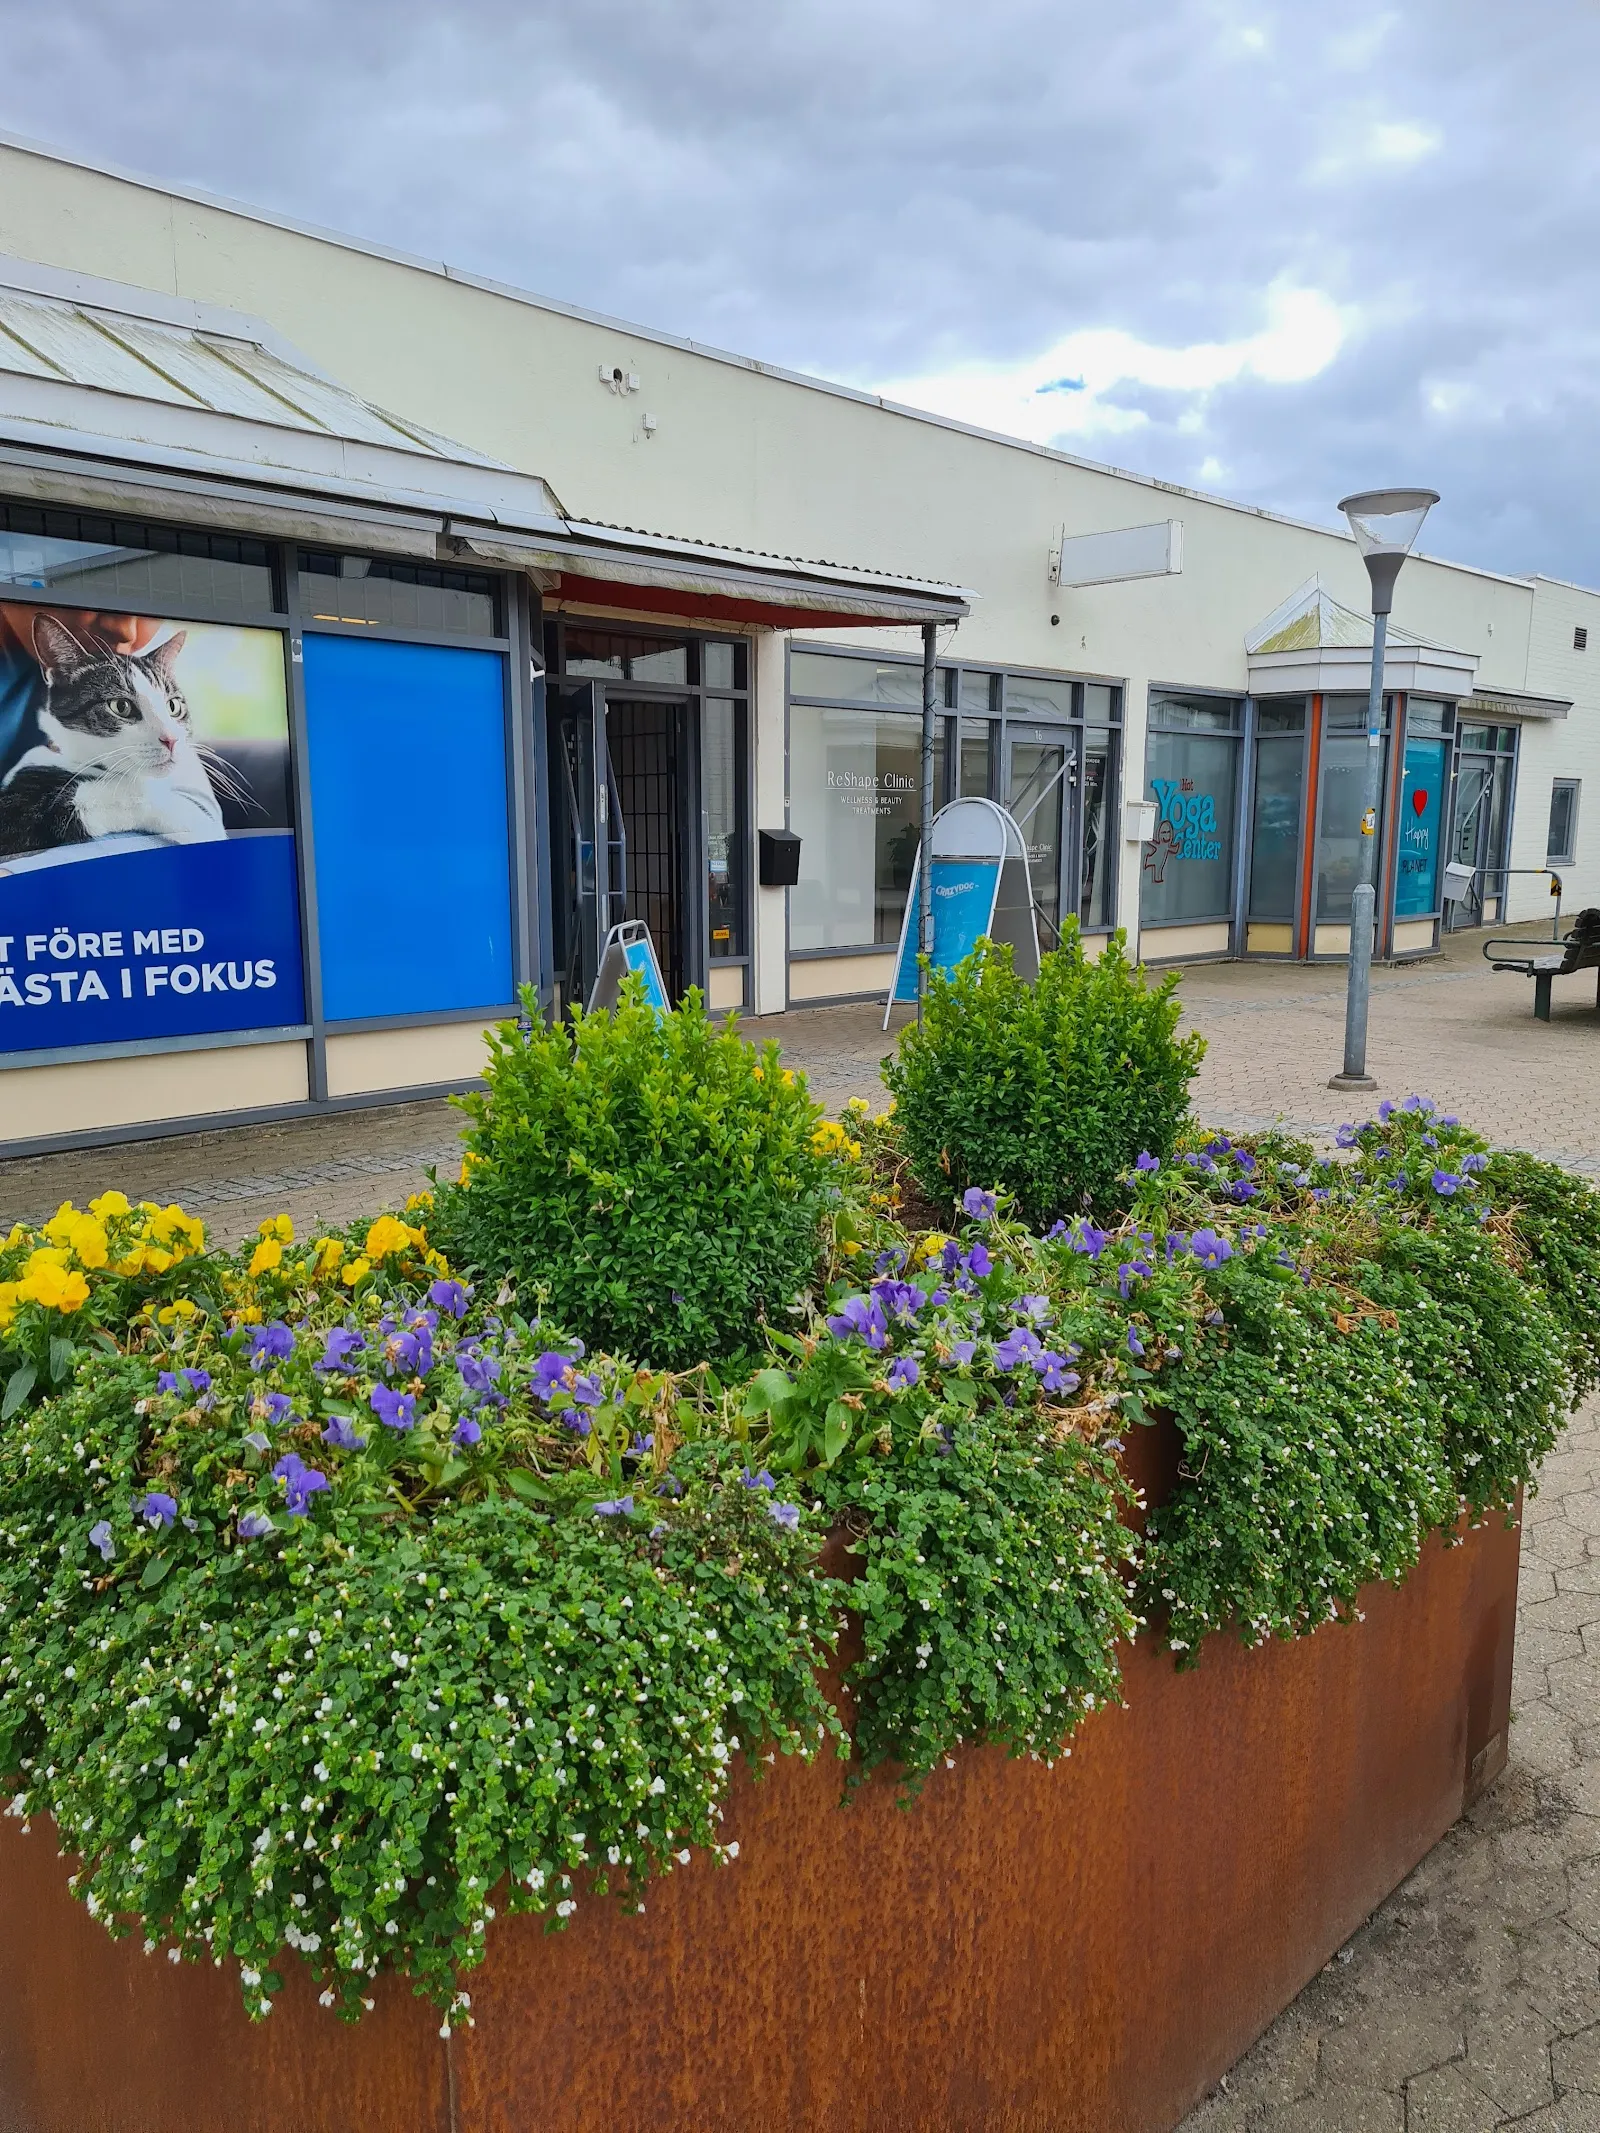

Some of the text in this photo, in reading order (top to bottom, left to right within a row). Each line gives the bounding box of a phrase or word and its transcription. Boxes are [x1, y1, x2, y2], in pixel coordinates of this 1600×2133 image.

[827, 771, 914, 790] ReShape Clinic
[1181, 779, 1194, 791] Hot
[840, 795, 873, 804] WELLNESS
[880, 797, 902, 805] BEAUTY
[852, 807, 891, 815] TREATMENTS
[1151, 778, 1217, 839] Yoga
[1405, 816, 1429, 850] Happy
[1174, 832, 1221, 860] Center
[1402, 858, 1428, 873] PLANET
[26, 927, 124, 961] FÖRE
[133, 928, 204, 956] MED
[0, 959, 276, 1007] ÄSTA I FOKUS
